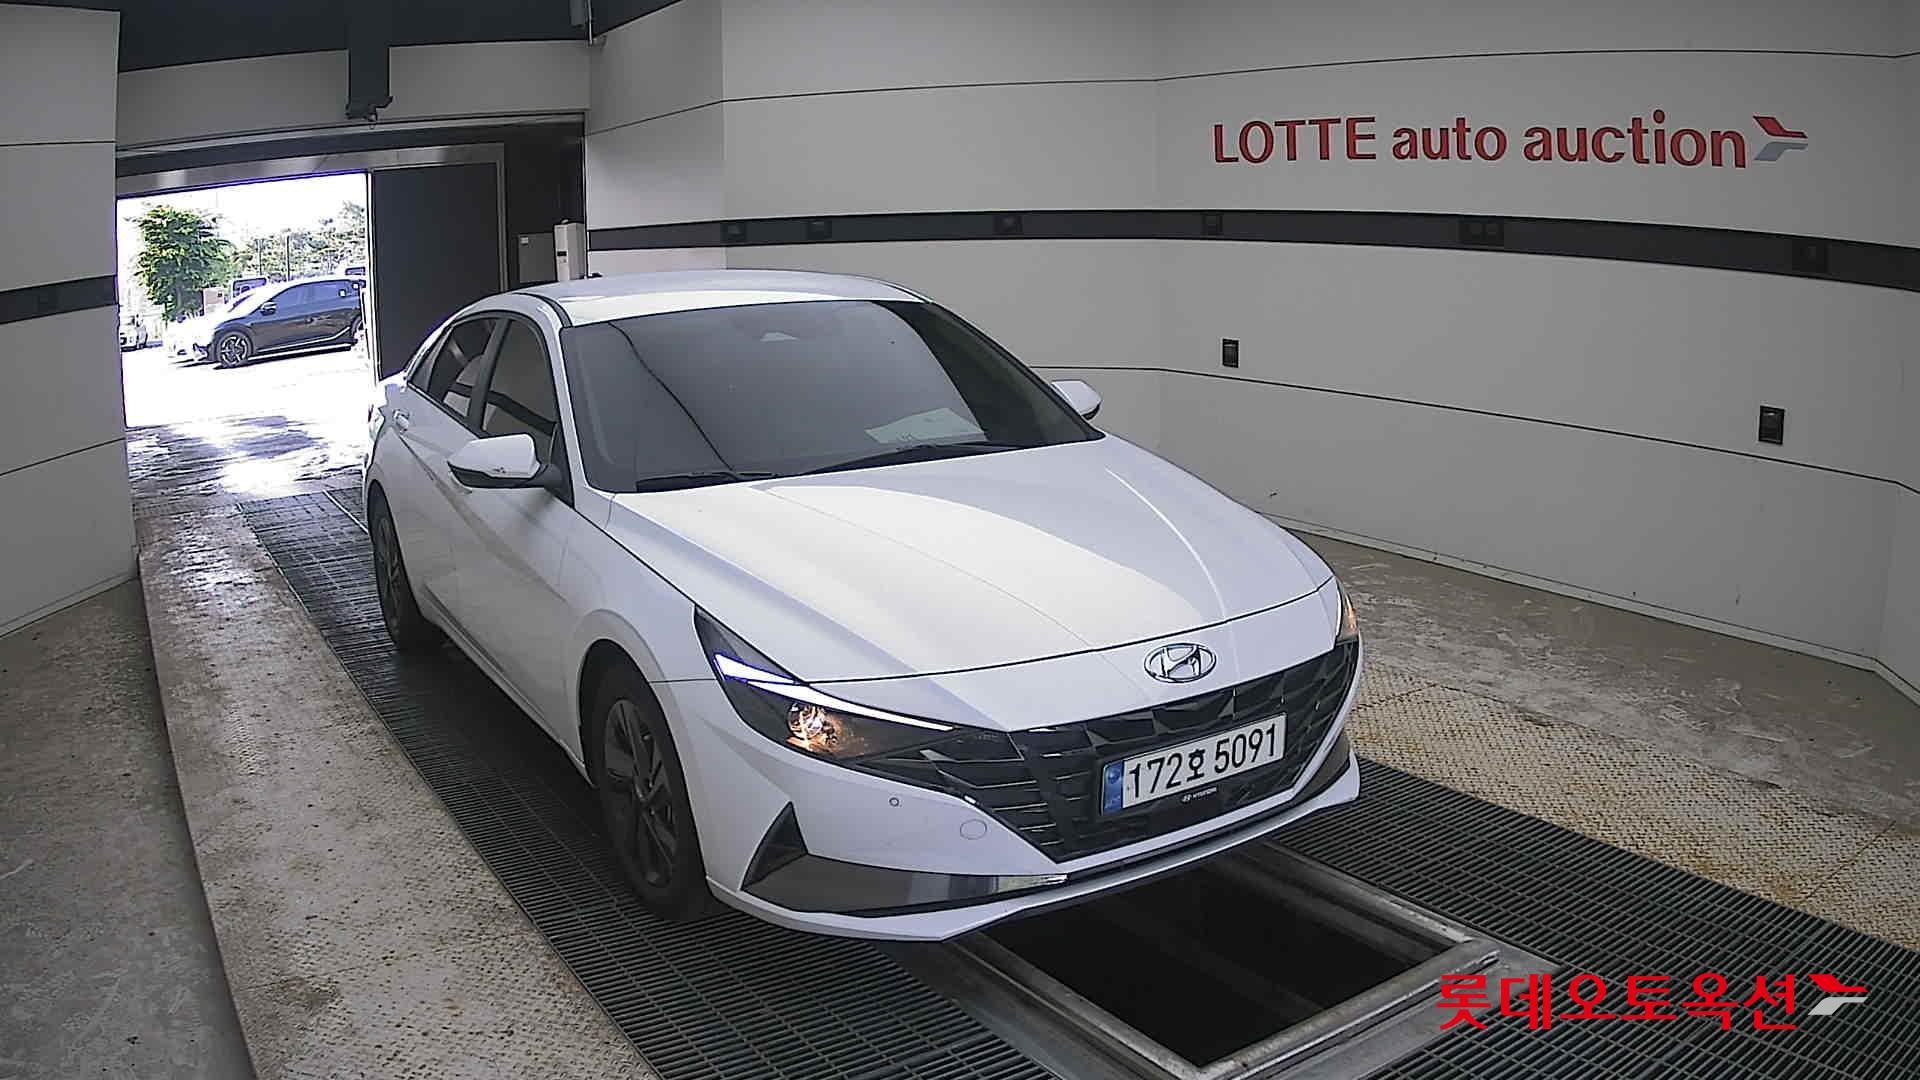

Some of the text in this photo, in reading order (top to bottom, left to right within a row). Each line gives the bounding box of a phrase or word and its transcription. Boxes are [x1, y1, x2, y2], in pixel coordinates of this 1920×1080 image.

[1214, 109, 1746, 168] LOTTE auto auction
[1128, 723, 1276, 798] 172호 5091
